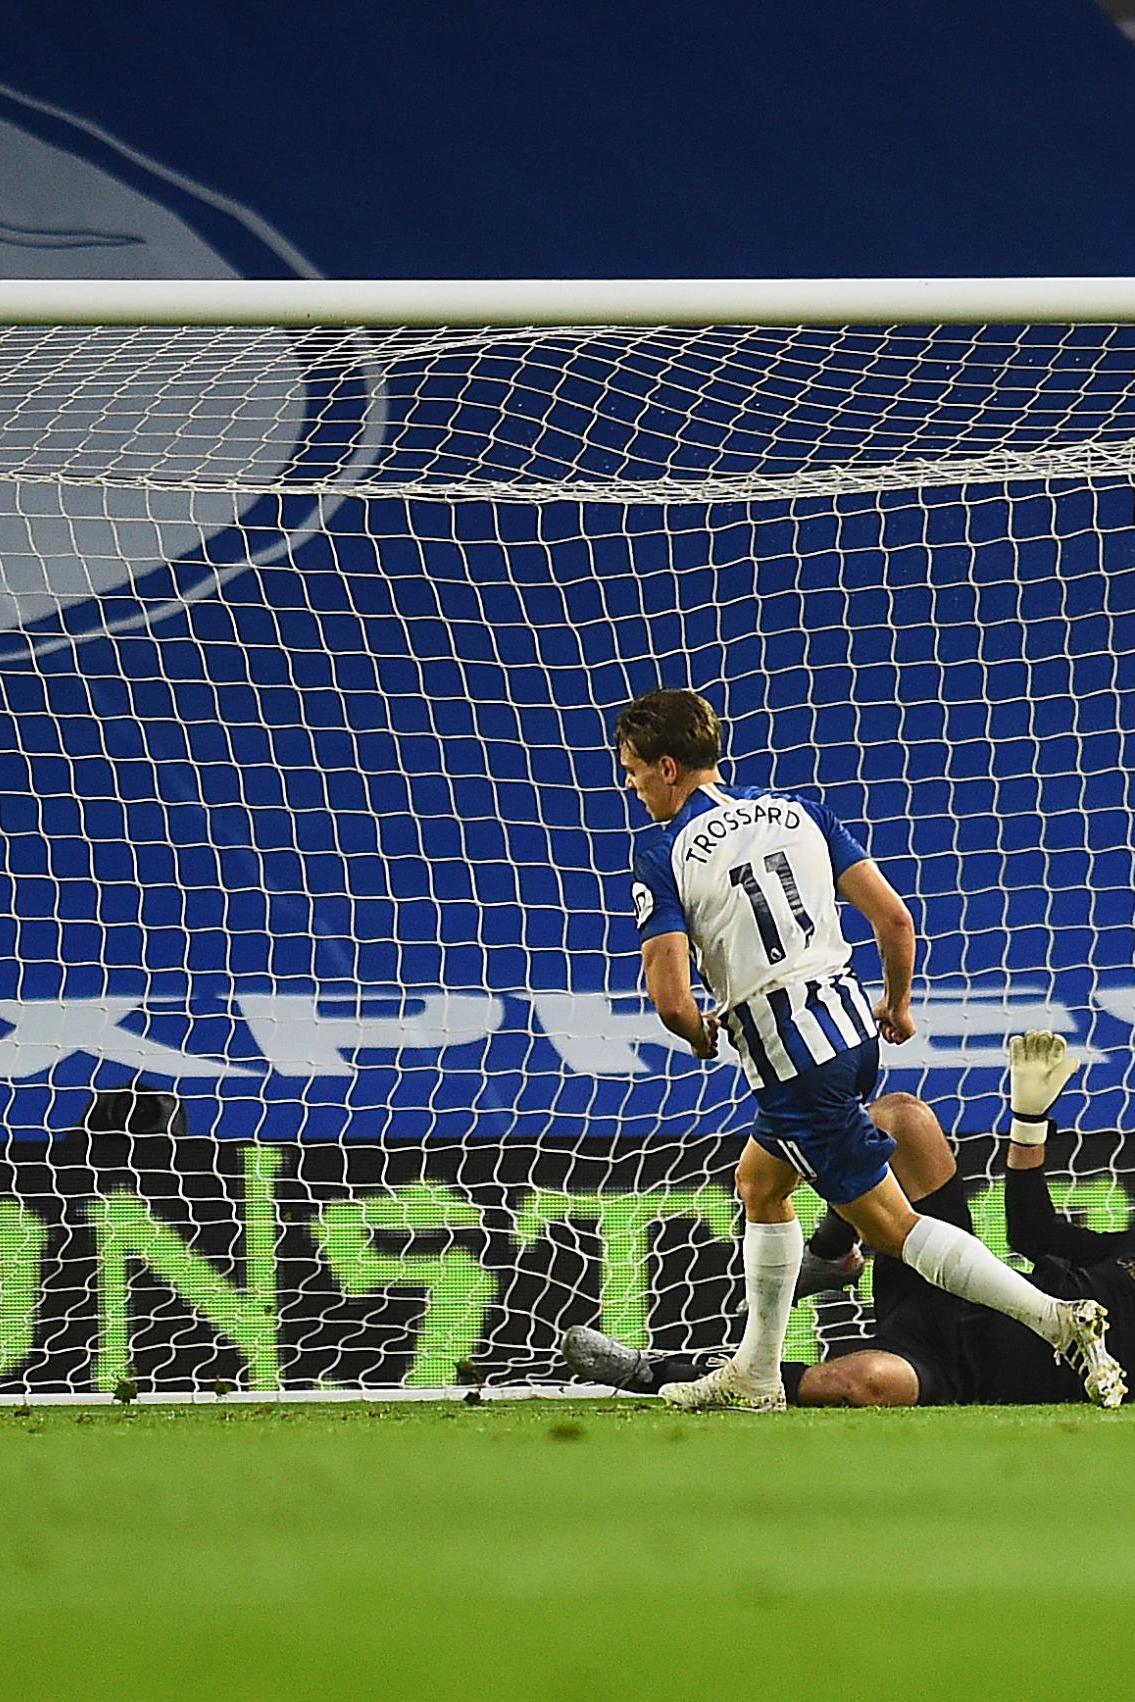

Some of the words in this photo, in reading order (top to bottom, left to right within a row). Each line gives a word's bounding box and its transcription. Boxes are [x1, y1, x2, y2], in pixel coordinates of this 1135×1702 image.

[685, 804, 800, 865] TROSSARD
[729, 850, 816, 966] 11
[776, 1138, 818, 1178] 11
